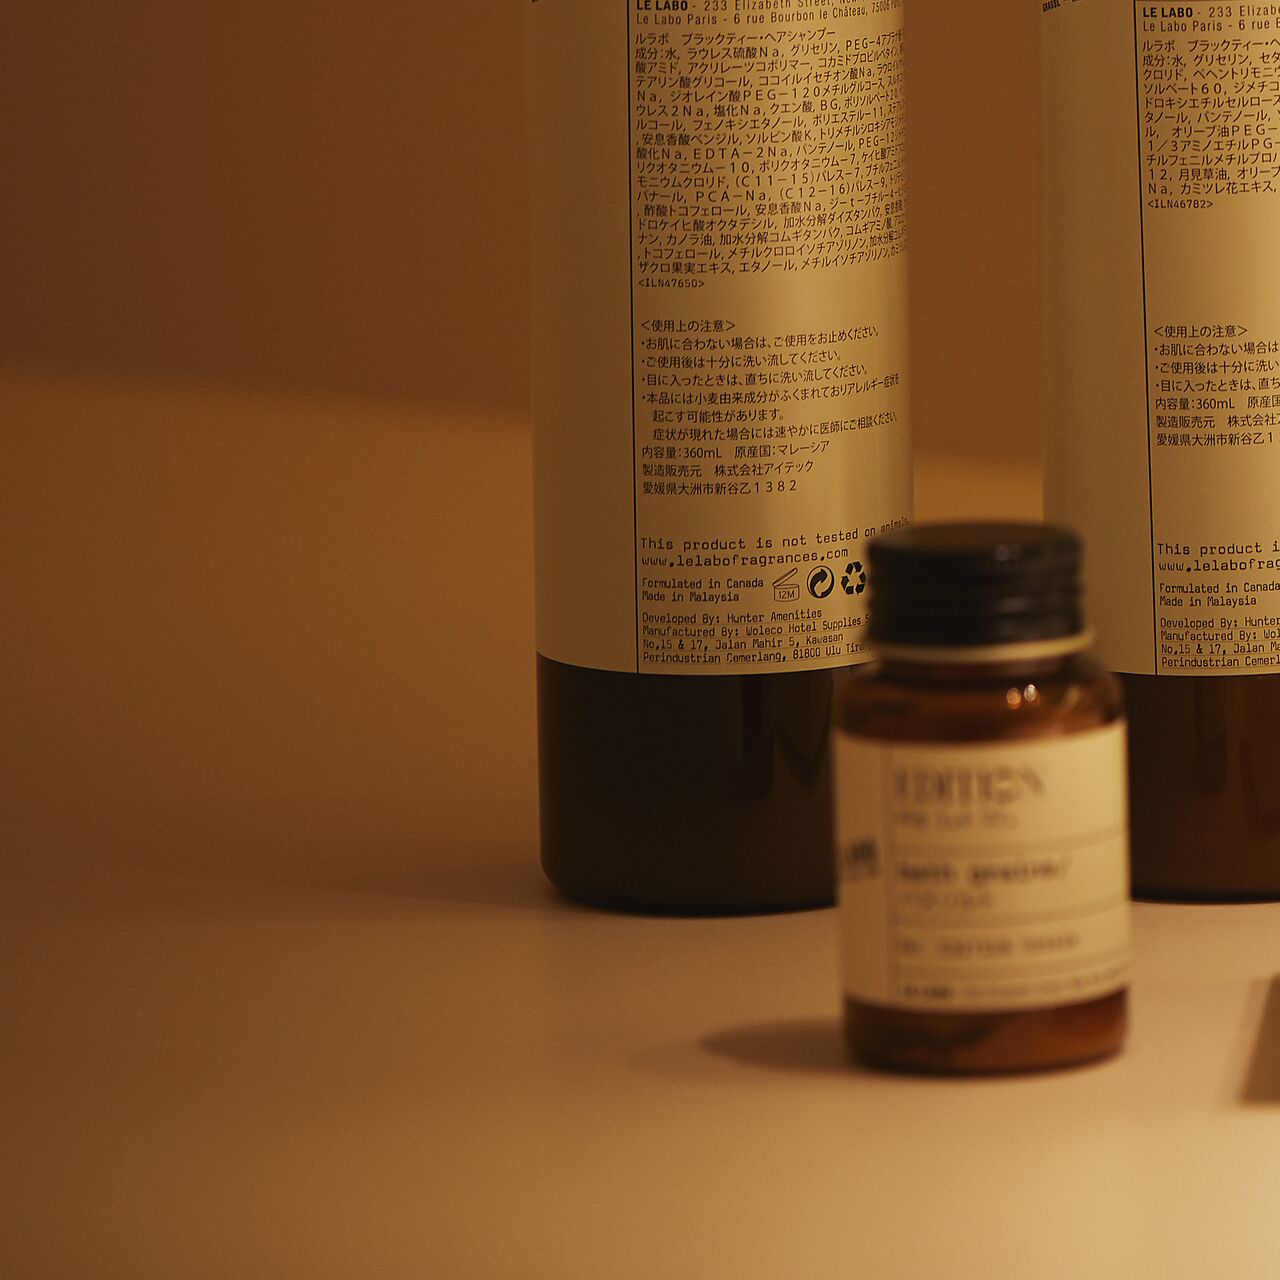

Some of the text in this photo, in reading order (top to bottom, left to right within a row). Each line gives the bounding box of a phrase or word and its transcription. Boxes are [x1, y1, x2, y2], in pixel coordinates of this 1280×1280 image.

[1156, 414, 1216, 431] 製造販売元
[642, 459, 813, 479] 製造販売元 株式会社アイテック
[640, 537, 673, 551] This
[683, 538, 746, 554] product
[756, 537, 773, 549] is
[782, 534, 807, 548] not
[816, 528, 858, 546] tested
[864, 527, 876, 537] on
[642, 547, 848, 567] www.lelabofragrances.com
[1157, 543, 1190, 557] This
[1200, 542, 1263, 559] product
[1159, 580, 1280, 596] Formulated in Canada
[1159, 593, 1257, 609] Made in Malaysia
